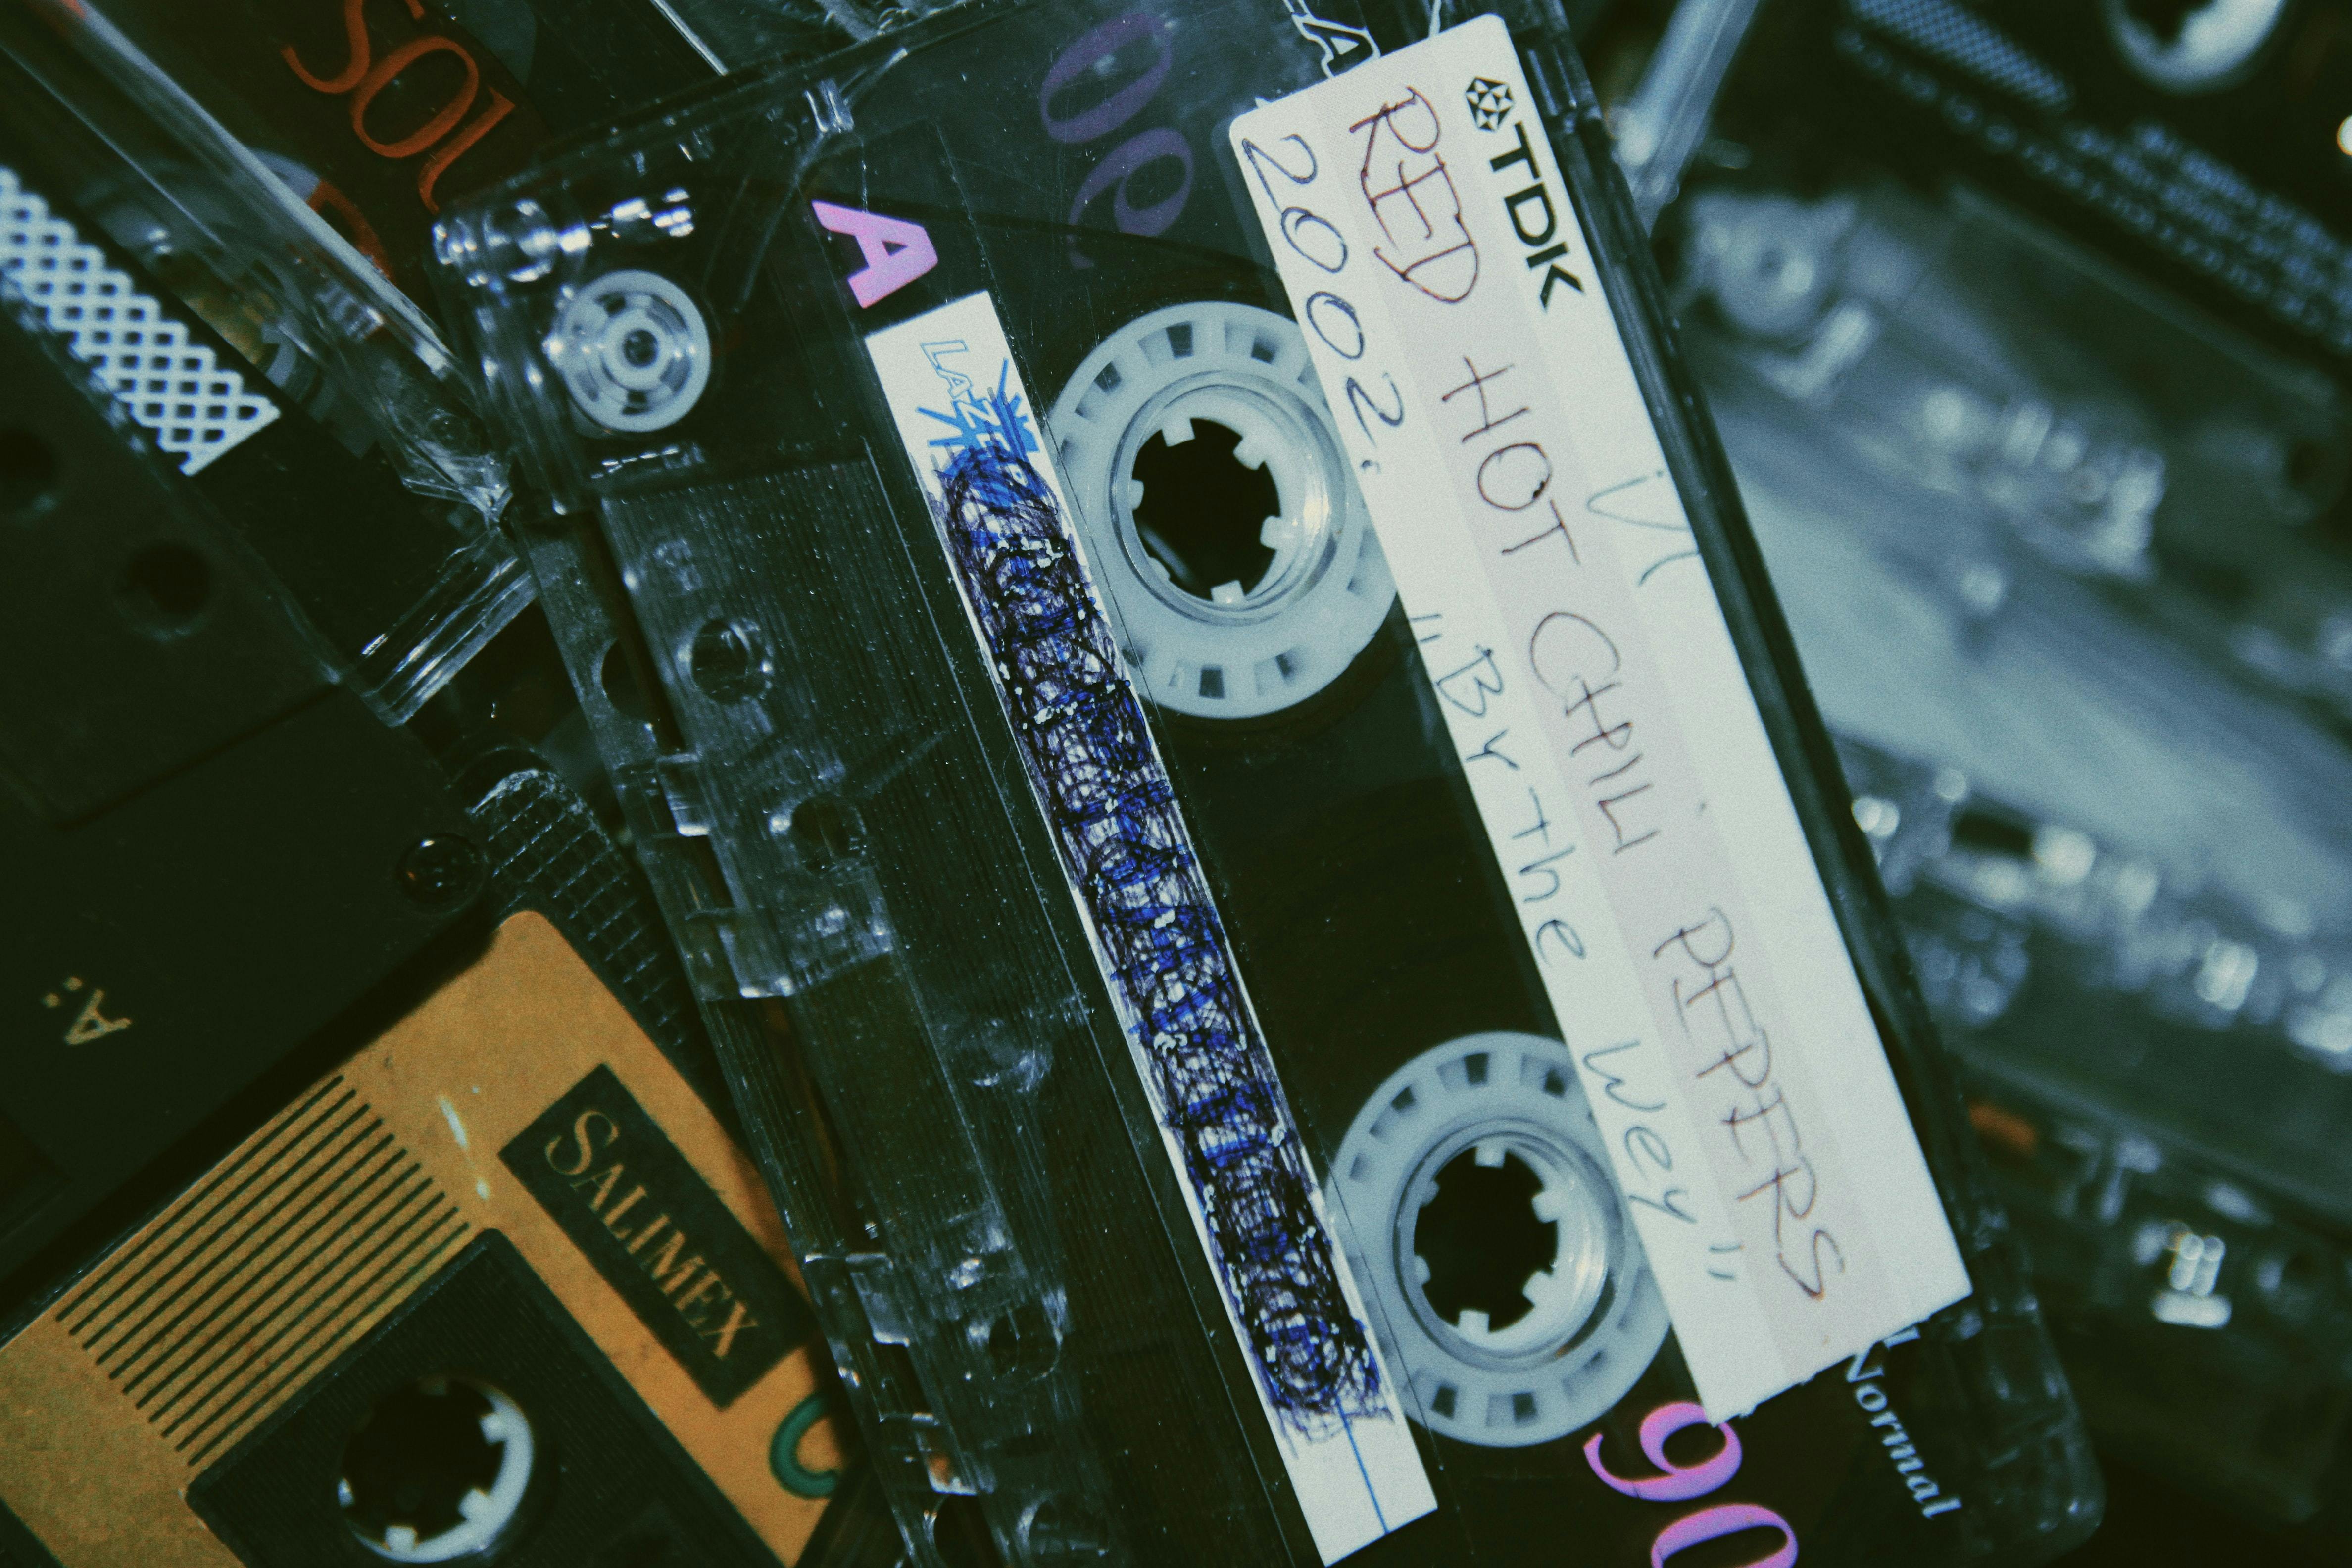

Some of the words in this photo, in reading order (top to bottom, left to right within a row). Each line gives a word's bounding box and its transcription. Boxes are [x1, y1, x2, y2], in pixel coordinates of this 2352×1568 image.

[811, 199, 939, 309] A
[1489, 121, 1585, 314] TDK
[1349, 86, 1478, 303] RED
[1442, 355, 1580, 565] HOT
[1653, 906, 1845, 1301] PEPERS
[544, 1109, 758, 1361] SALIMEX
[1583, 1401, 1799, 1568] 90
[1845, 1353, 1962, 1520] Normal
